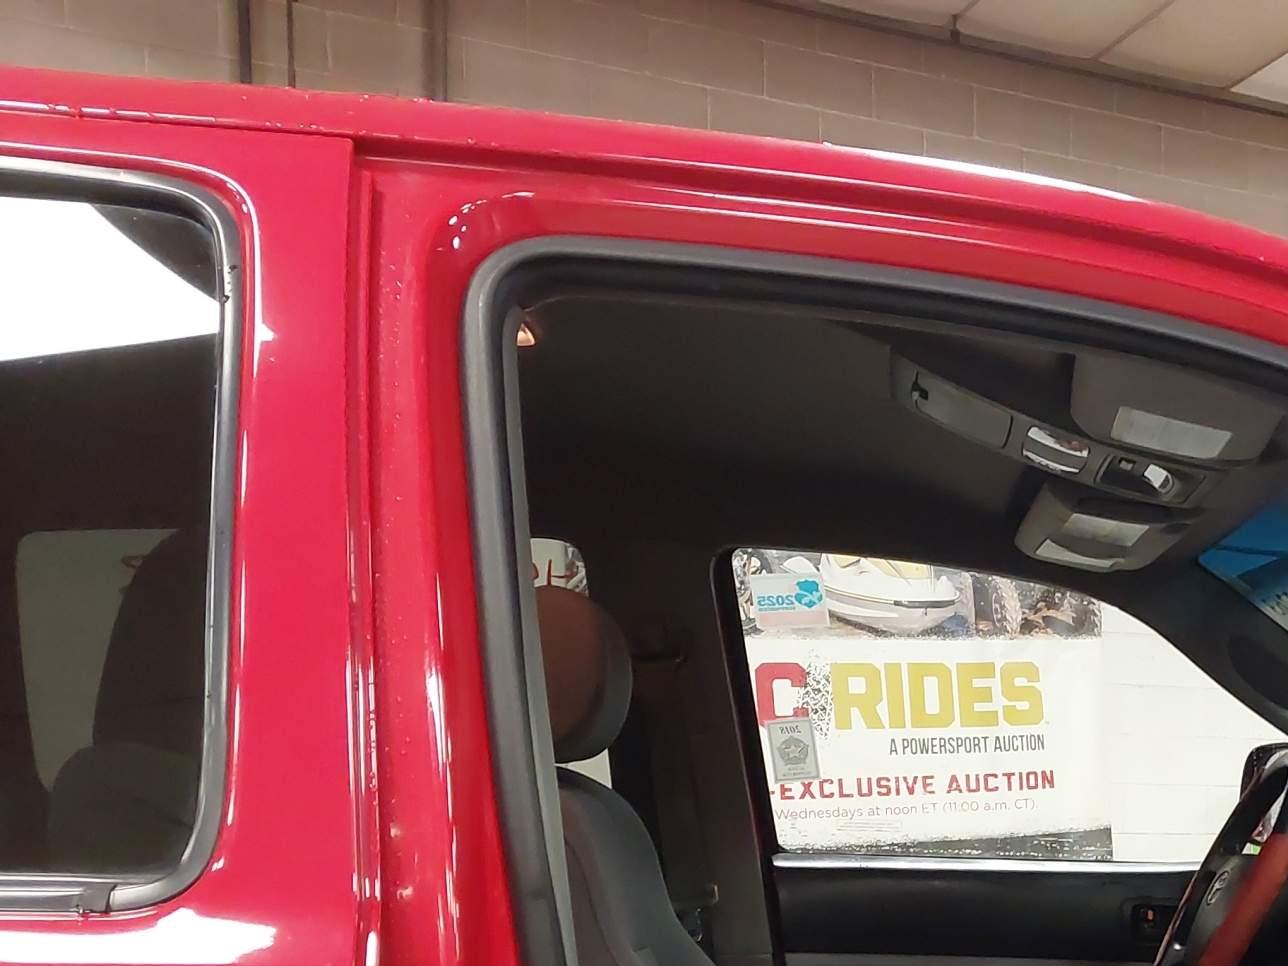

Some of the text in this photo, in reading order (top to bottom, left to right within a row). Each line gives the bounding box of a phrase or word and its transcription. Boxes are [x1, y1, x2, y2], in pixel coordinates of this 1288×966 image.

[832, 661, 1044, 730] RIDES
[889, 733, 1045, 756] A POWERSPORT AUCTION
[946, 769, 1055, 794] AUCTION
[775, 806, 864, 821] Wednesdays
[867, 806, 881, 817] at
[885, 804, 918, 815] noon
[921, 801, 938, 814] ET
[983, 800, 1010, 812] a.m.
